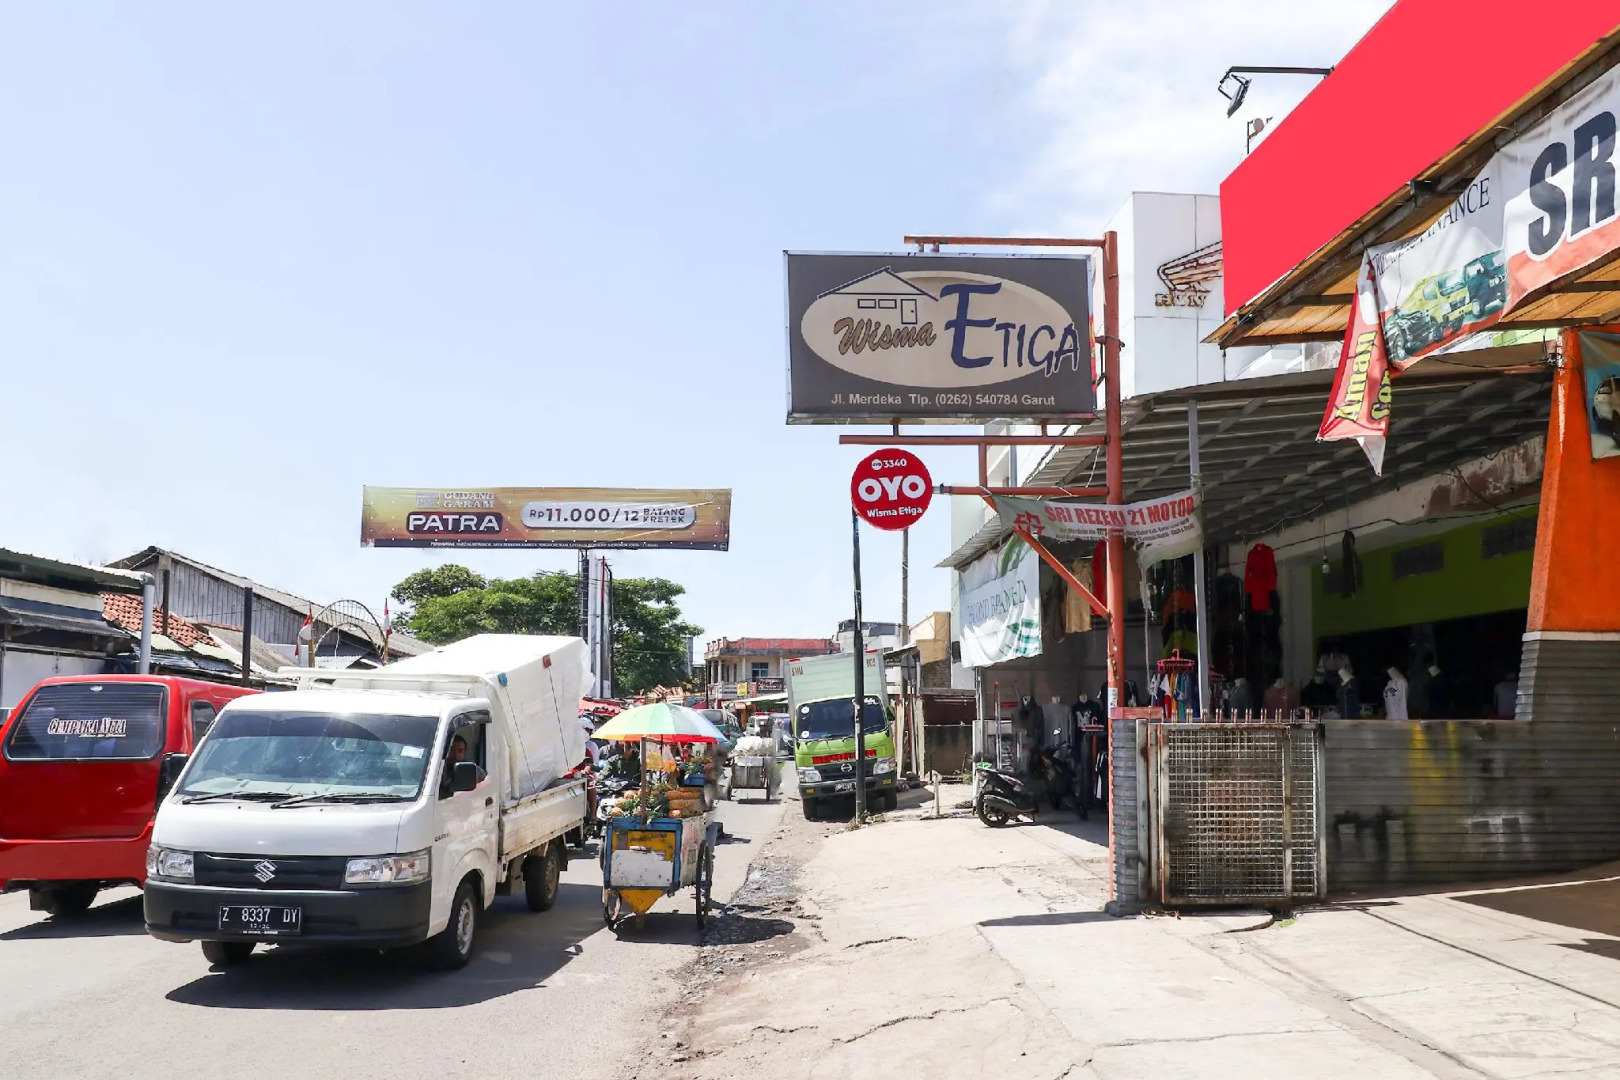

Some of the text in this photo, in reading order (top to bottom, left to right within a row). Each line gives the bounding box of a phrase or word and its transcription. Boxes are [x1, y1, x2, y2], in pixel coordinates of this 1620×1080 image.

[834, 317, 937, 355] Wisma
[831, 394, 1055, 407] Jl. Merdeka Tlp. (0262) 540784 Garut
[883, 458, 907, 468] 3340
[858, 475, 926, 502] OYO
[444, 491, 495, 500] GUDANG
[443, 500, 495, 508] GARAM
[643, 508, 686, 516] BATANG
[867, 506, 923, 518] Wisma Etiga
[1044, 505, 1074, 523] SRI
[1127, 510, 1146, 527] 21
[408, 514, 500, 531] PATRA
[222, 907, 297, 923] Z 8337 DY
